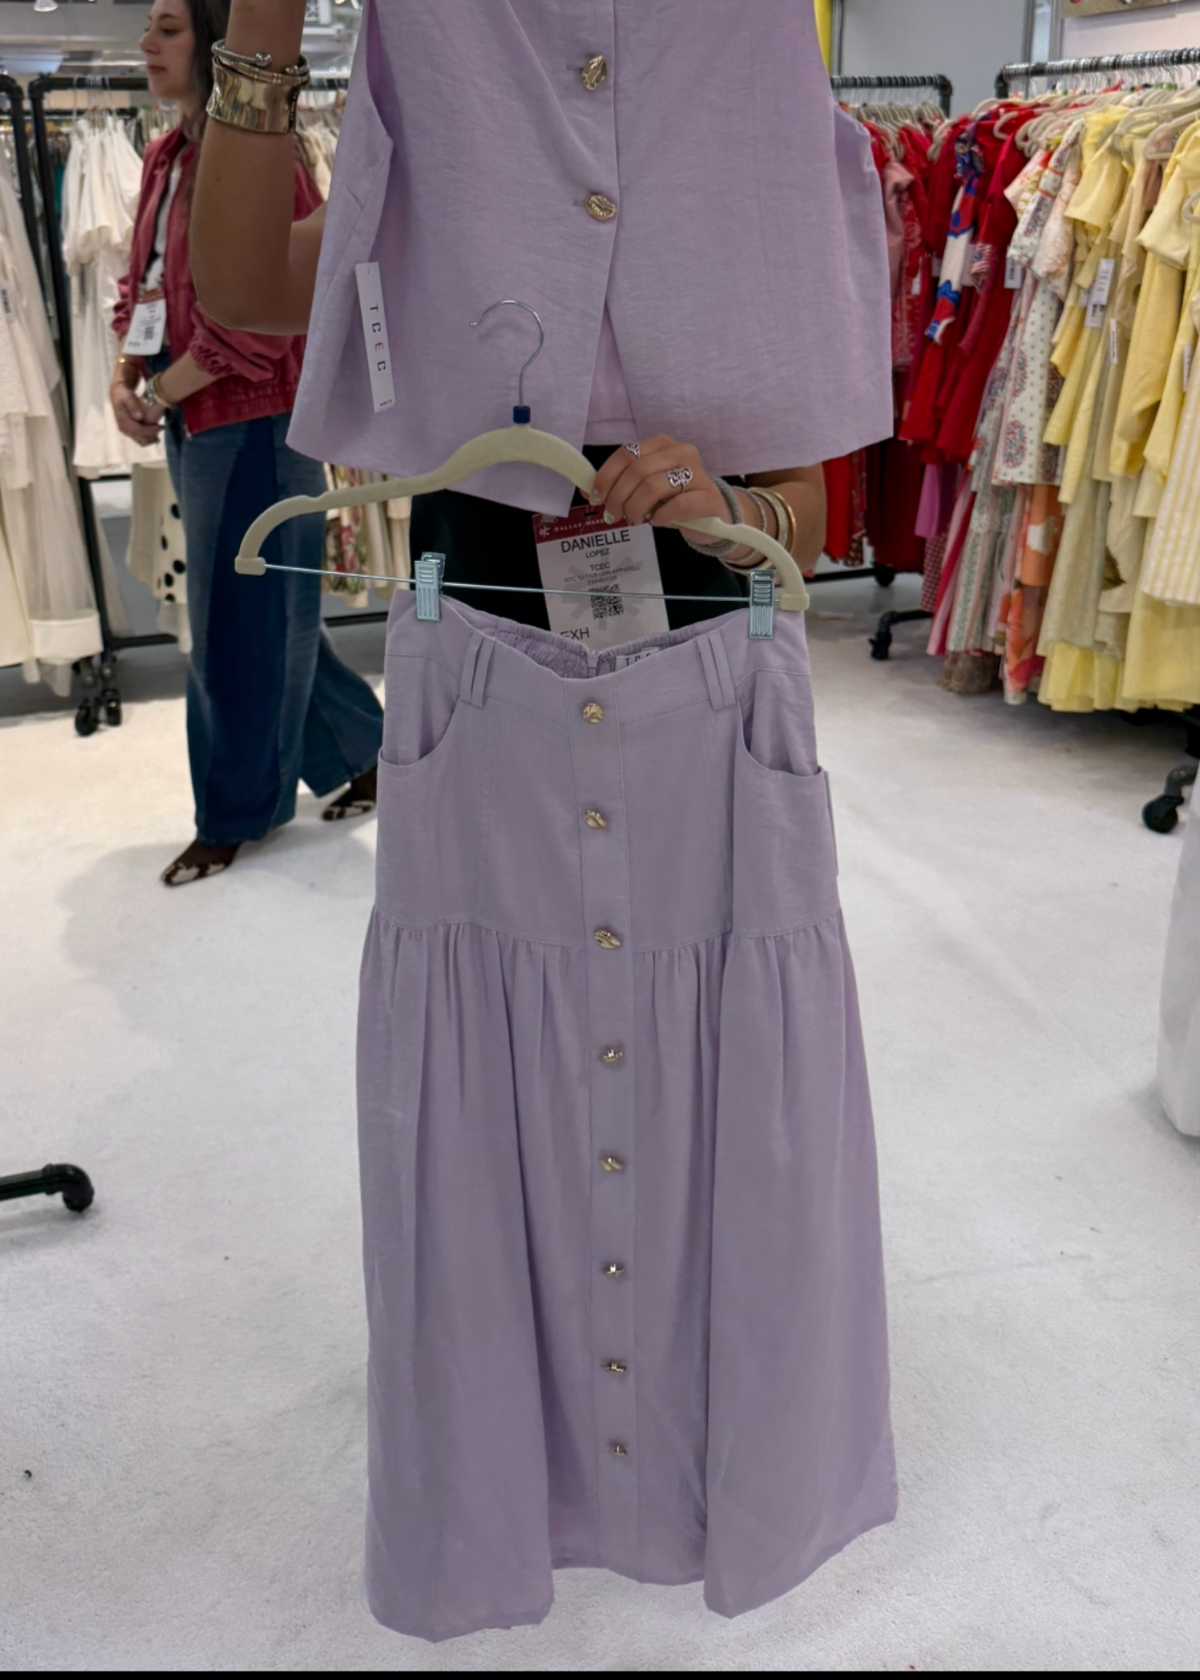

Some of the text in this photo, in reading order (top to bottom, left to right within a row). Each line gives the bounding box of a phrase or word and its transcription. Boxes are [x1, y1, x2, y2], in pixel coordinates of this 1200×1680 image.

[369, 303, 386, 372] TCEC
[554, 522, 582, 533] DALLAS
[561, 529, 631, 553] DANIELLE
[585, 548, 610, 559] LOPEZ
[590, 562, 610, 571] TCEC
